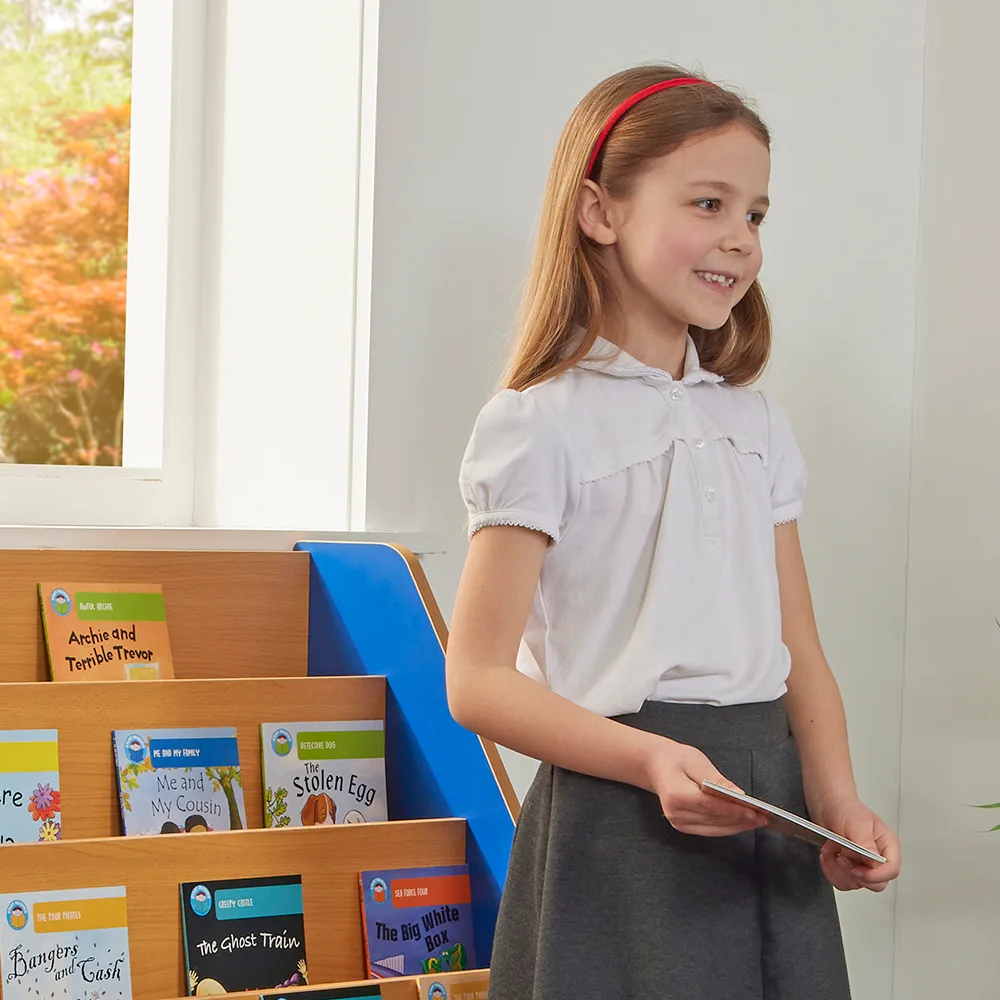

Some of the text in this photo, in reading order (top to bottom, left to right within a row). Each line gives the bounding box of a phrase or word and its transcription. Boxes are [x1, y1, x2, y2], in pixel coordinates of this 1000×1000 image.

[68, 624, 136, 646] Archie and
[65, 645, 154, 672] Terrible Trevor
[153, 749, 161, 758] ME
[173, 748, 182, 757] MY
[182, 748, 200, 757] FAMILY
[326, 740, 336, 749] DOG
[304, 762, 320, 774] The
[156, 772, 205, 792] Me and
[292, 769, 376, 806] Stolen Egg
[151, 795, 222, 819] My Cousin
[376, 905, 460, 942] The Big White
[196, 930, 300, 956] The Ghost Train
[424, 930, 450, 952] Box
[8, 944, 79, 981] Bangers
[54, 955, 125, 982] and Cash
